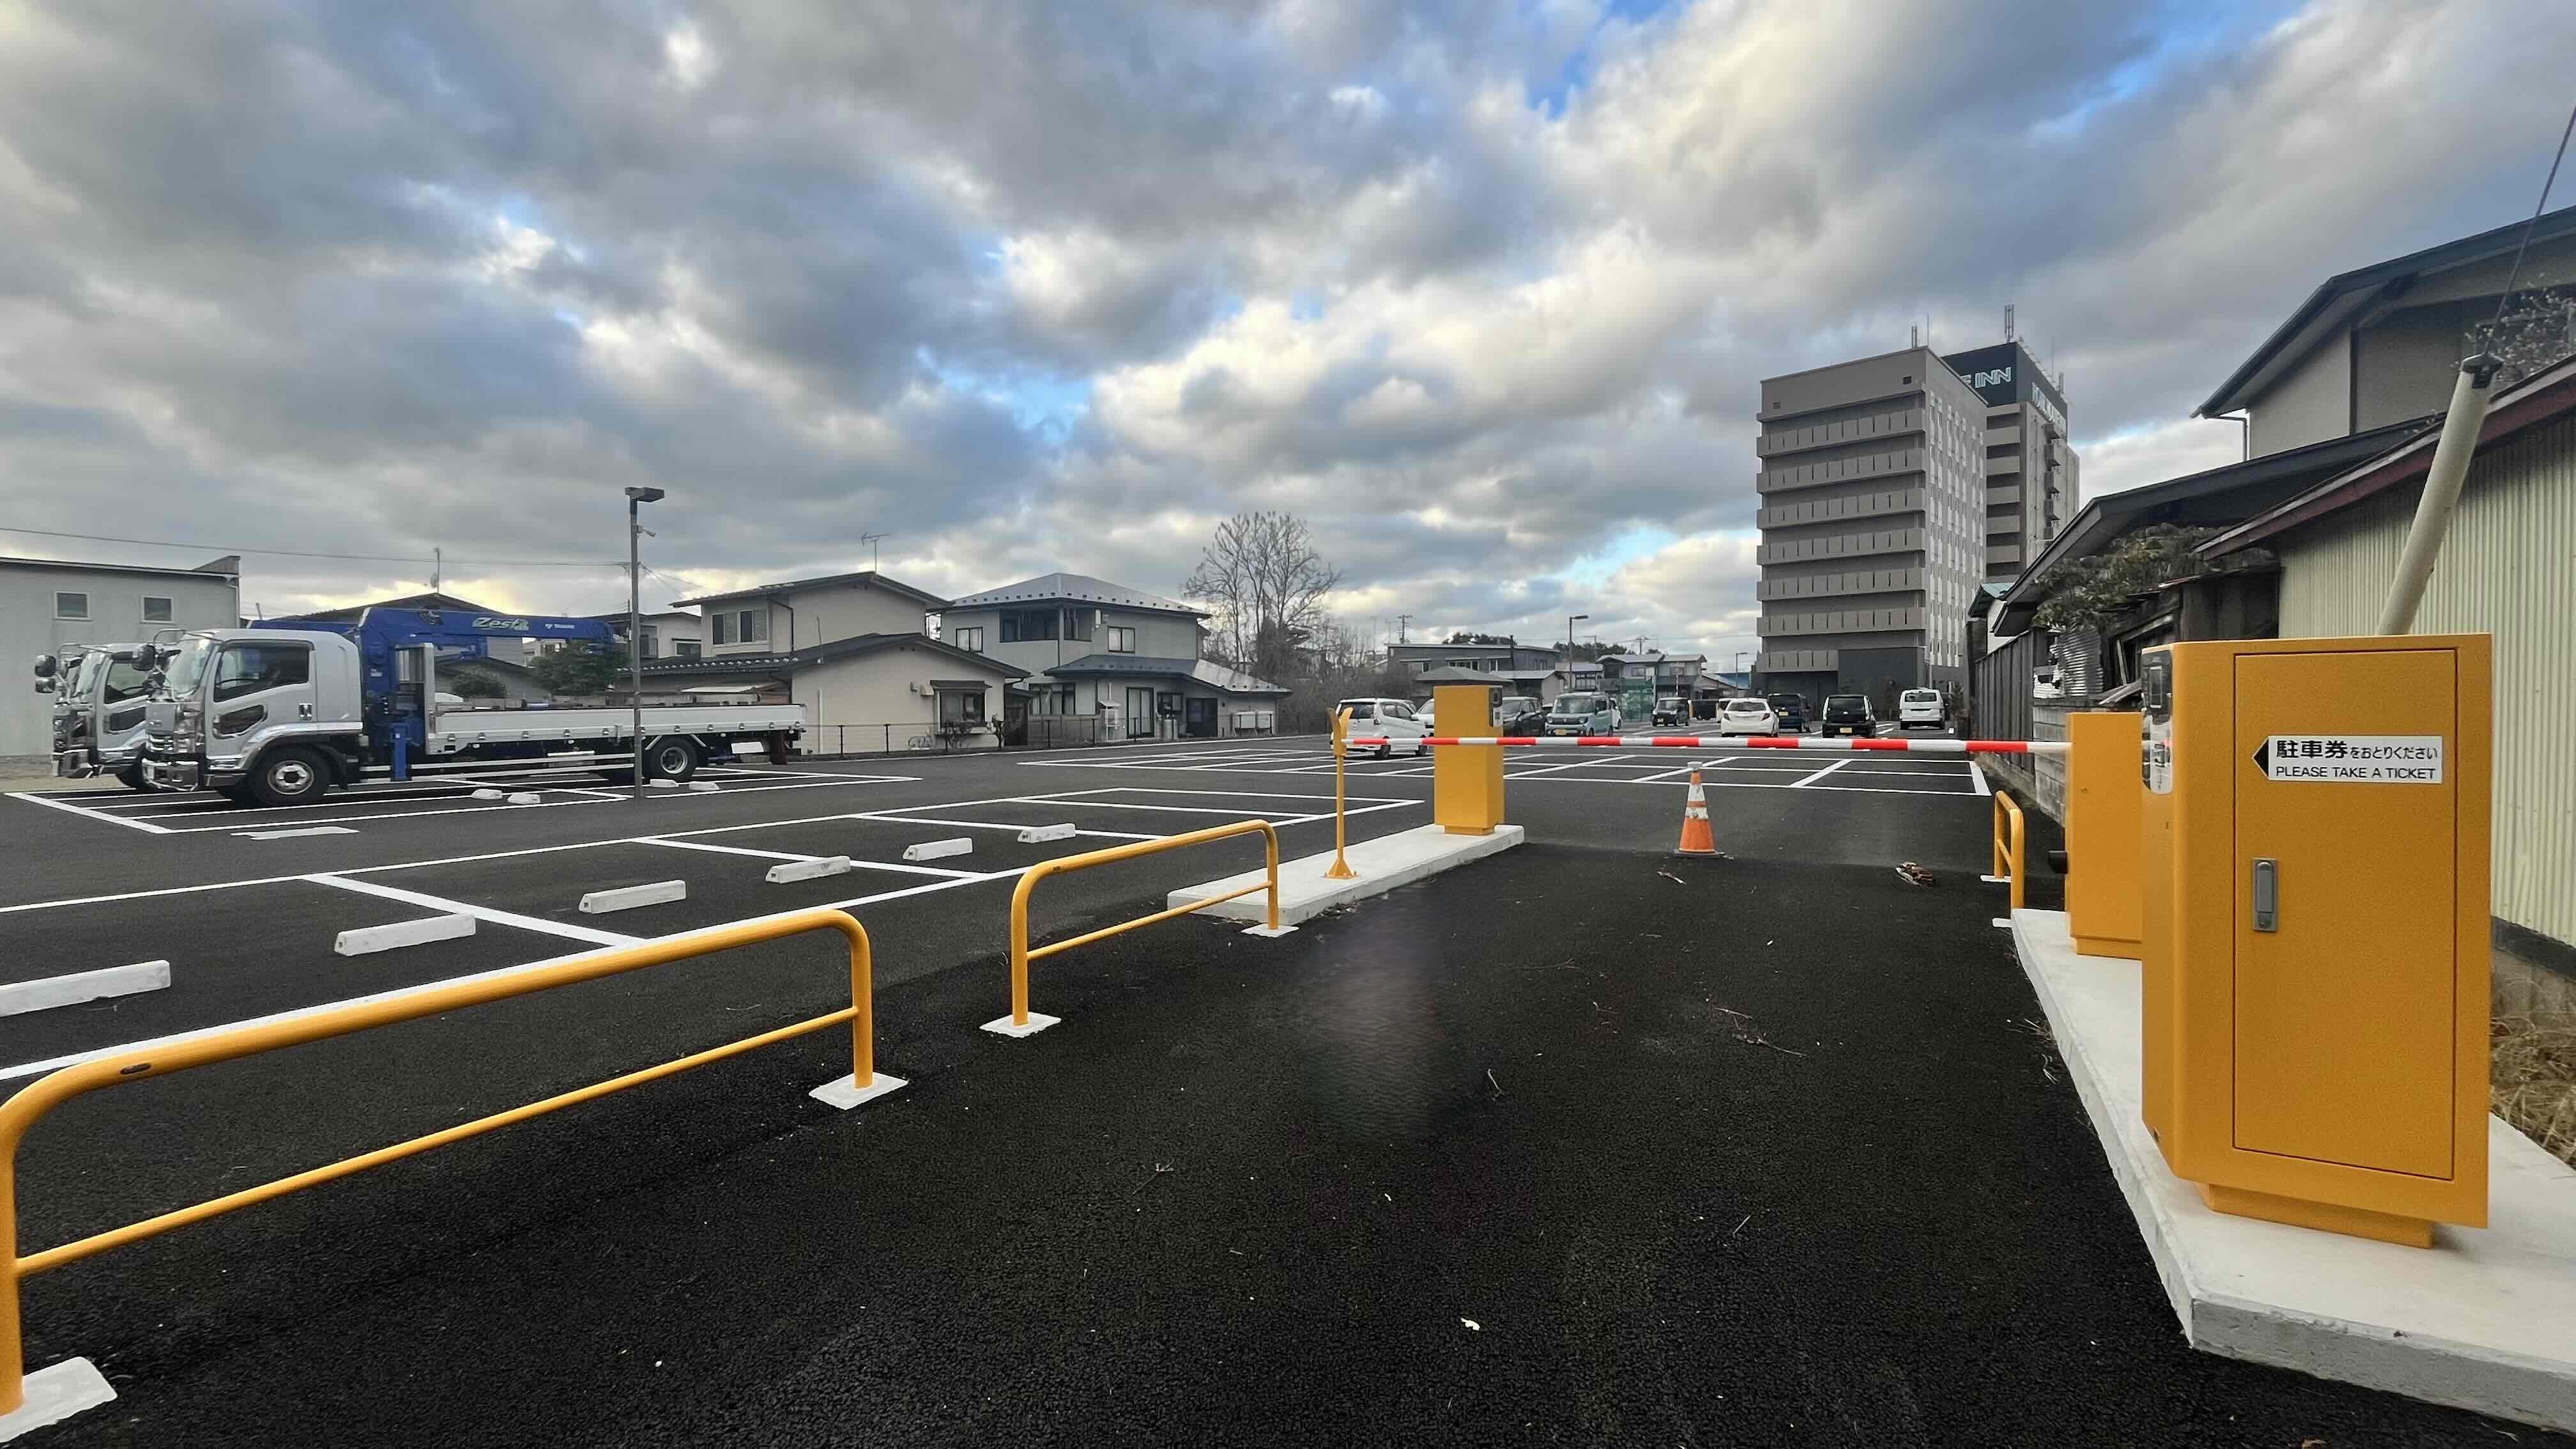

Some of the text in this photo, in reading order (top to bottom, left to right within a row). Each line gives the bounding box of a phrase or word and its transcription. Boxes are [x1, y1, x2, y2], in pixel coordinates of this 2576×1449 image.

[1975, 367, 2012, 389] INN
[2276, 740, 2438, 759] 駐車券をおとりください
[2276, 766, 2436, 779] PLEASE TAKE A TICKET
